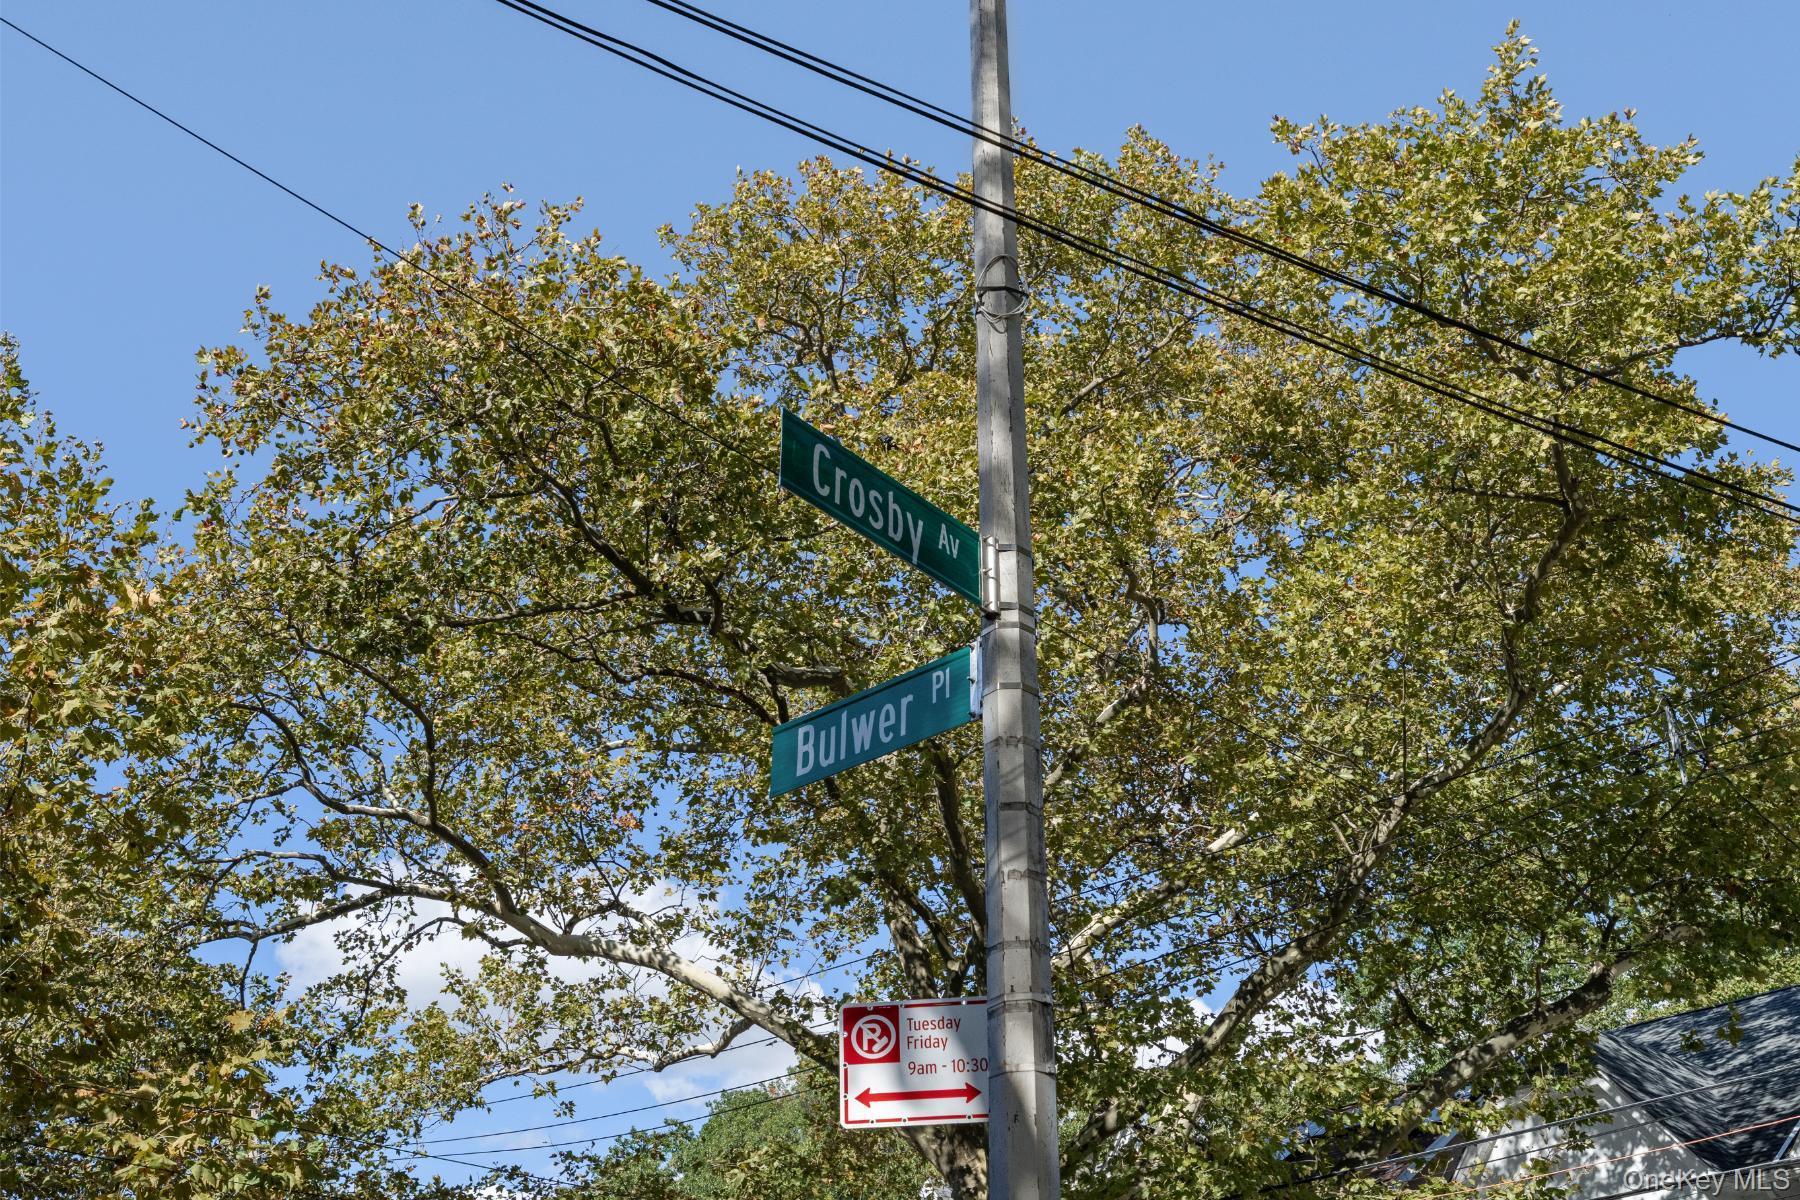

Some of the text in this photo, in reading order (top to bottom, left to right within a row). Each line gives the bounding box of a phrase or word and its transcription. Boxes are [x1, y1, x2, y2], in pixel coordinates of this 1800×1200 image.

[813, 443, 923, 564] Crosby
[796, 667, 950, 777] Bulwer Pl
[906, 1016, 961, 1032] Tuesday
[907, 1035, 948, 1051] Friday
[908, 1061, 937, 1075] 9am
[952, 1058, 988, 1073] 10:30
